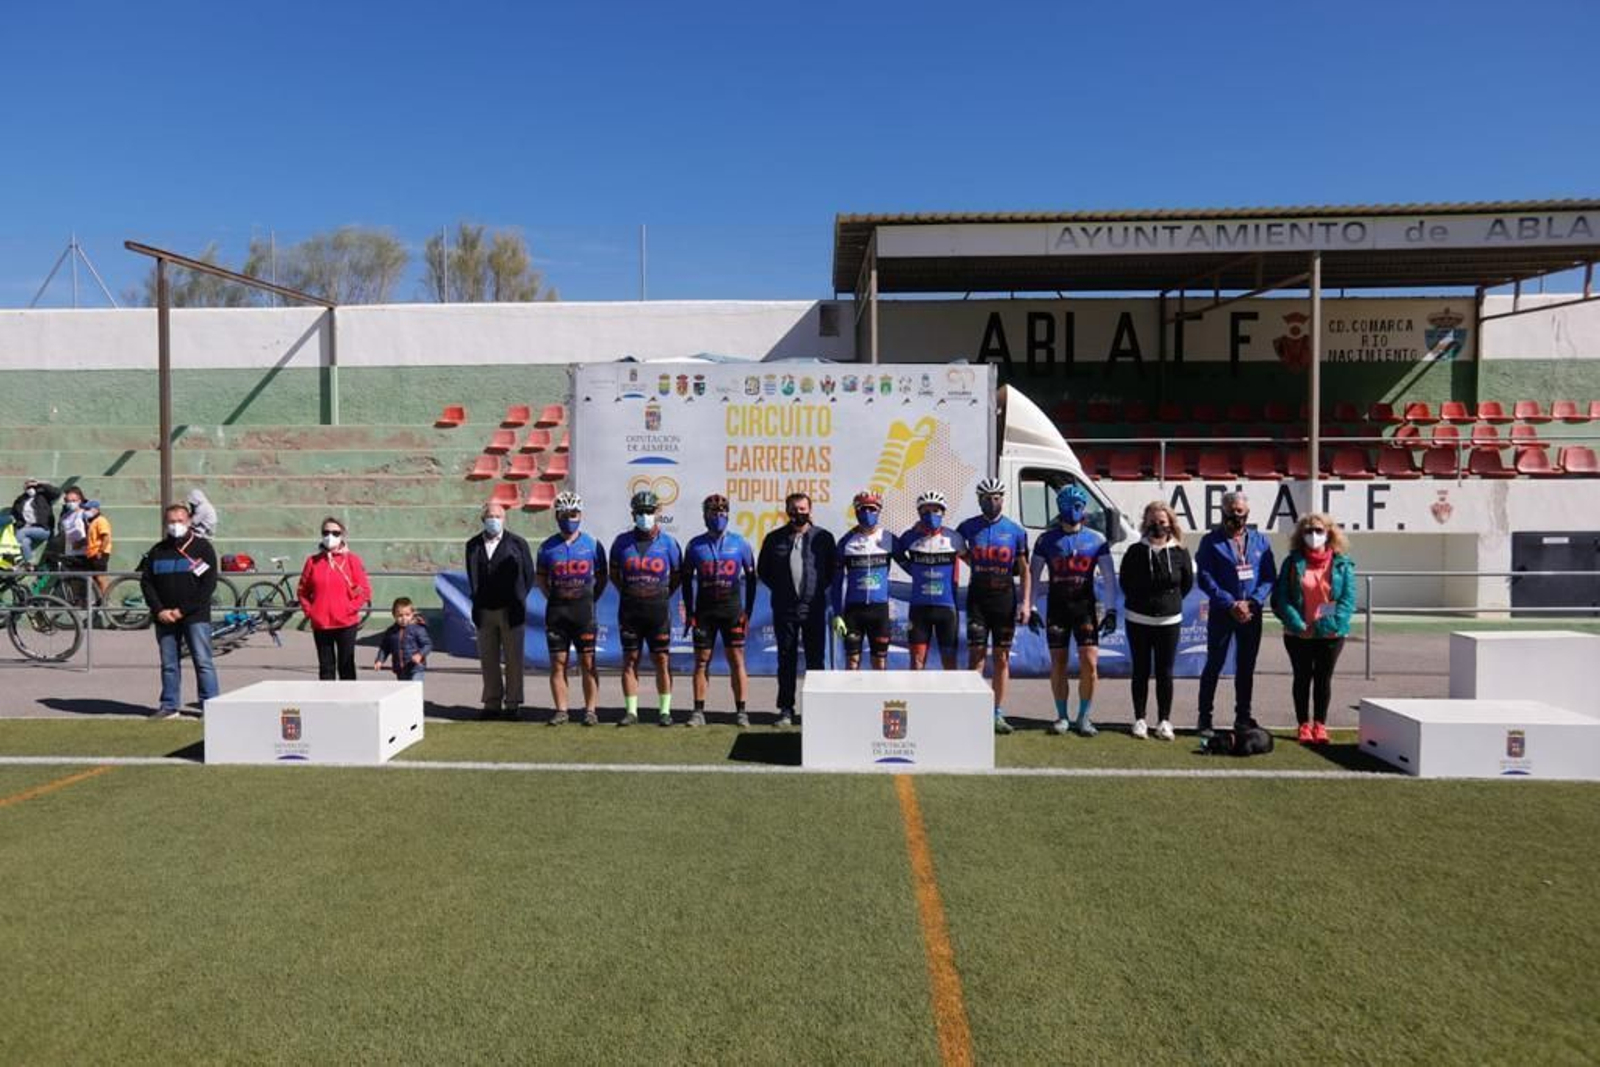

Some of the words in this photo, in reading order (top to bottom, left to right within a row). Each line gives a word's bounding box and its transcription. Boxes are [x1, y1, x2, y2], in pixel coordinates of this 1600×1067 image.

[1055, 221, 1368, 248] AYUNTAMIENTO
[1405, 220, 1448, 242] de
[1485, 215, 1594, 241] ABLA
[1361, 334, 1388, 348] RIO
[1328, 349, 1420, 362] NACIMIENTO
[725, 404, 833, 437] CIRCUITO
[725, 445, 832, 472] CARRERAS
